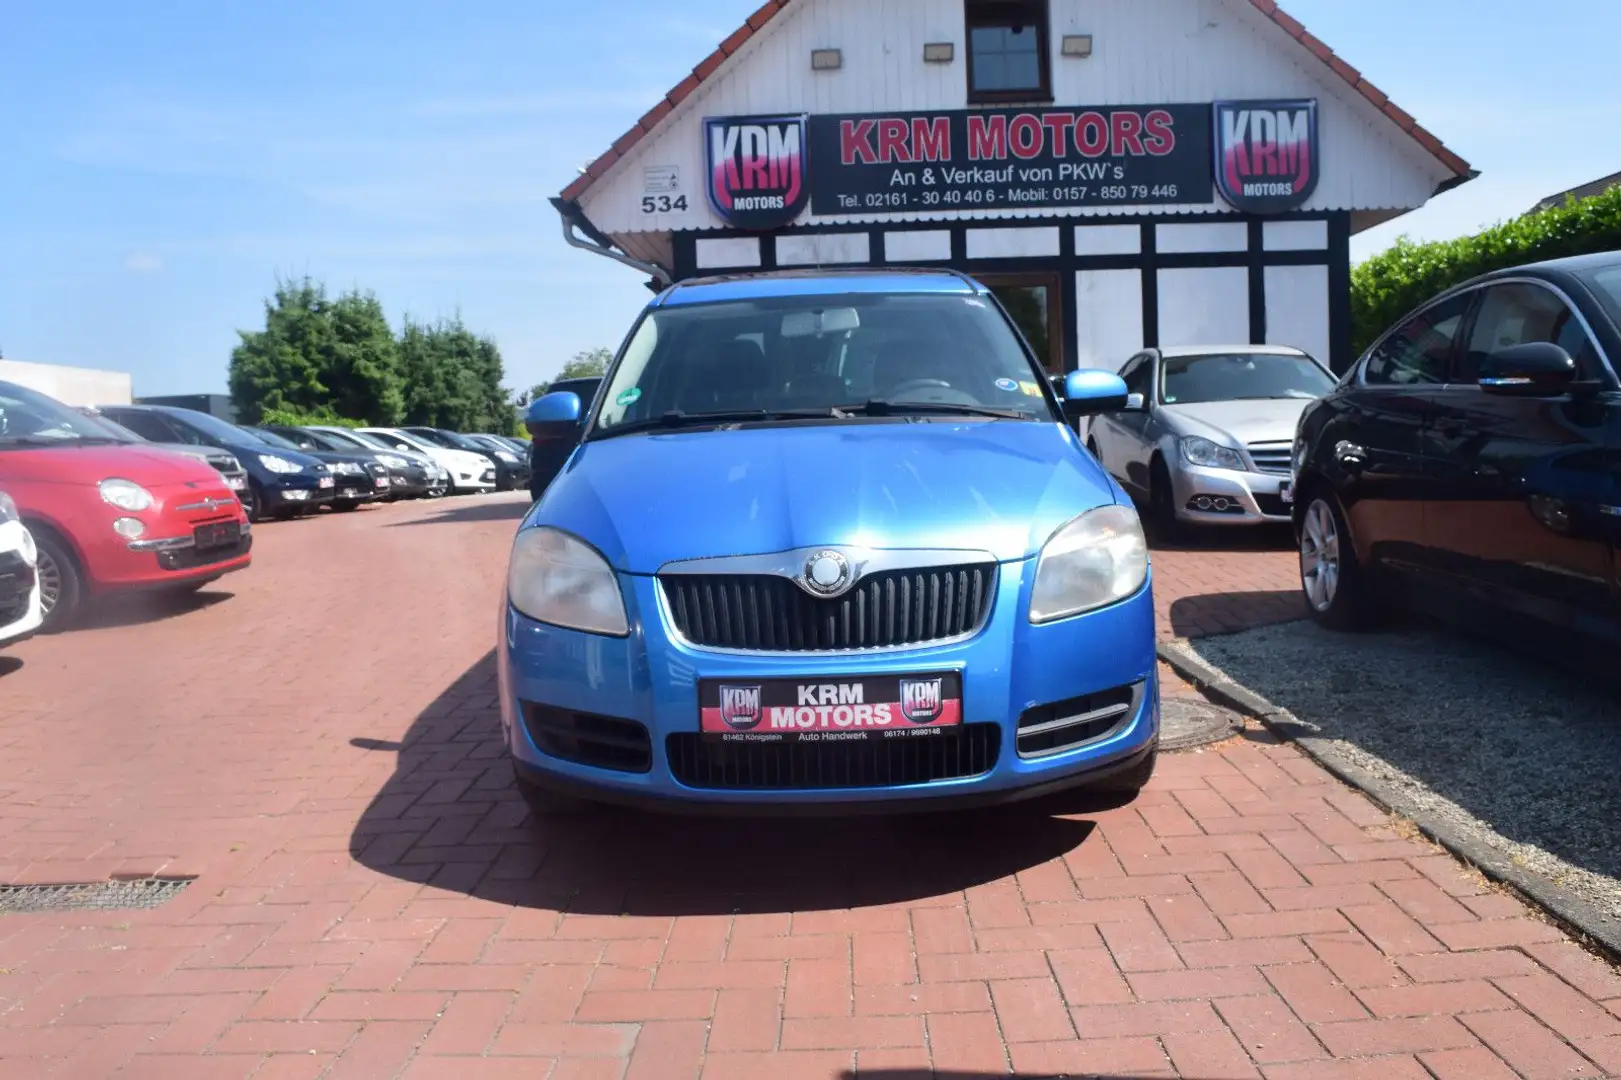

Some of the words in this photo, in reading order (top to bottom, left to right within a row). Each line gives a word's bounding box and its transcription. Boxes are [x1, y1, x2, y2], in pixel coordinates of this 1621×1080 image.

[840, 116, 951, 165] KRM
[966, 110, 1176, 160] MOTORS
[1222, 109, 1310, 196] KRM
[712, 123, 801, 209] KRM
[890, 168, 916, 186] An
[921, 167, 936, 185] &
[941, 165, 1014, 184] Verkauf
[1019, 167, 1053, 182] von
[837, 194, 861, 208] Tel.
[865, 193, 908, 207] 02161
[922, 191, 940, 205] 30
[943, 190, 961, 204] 40
[965, 189, 982, 203] 40
[985, 189, 995, 202] 6
[1008, 188, 1049, 202] Mobil:
[1052, 186, 1088, 200] 0157
[1100, 186, 1126, 199] 850
[1130, 185, 1148, 198] 79
[1151, 184, 1178, 198] 446
[1243, 183, 1293, 197] MOTORS
[642, 194, 689, 213] 534
[734, 195, 784, 210] MOTORS
[797, 683, 865, 706] KRM
[770, 703, 892, 729] MOTORS
[798, 732, 820, 741] Auto
[821, 731, 868, 741] Handwerk
